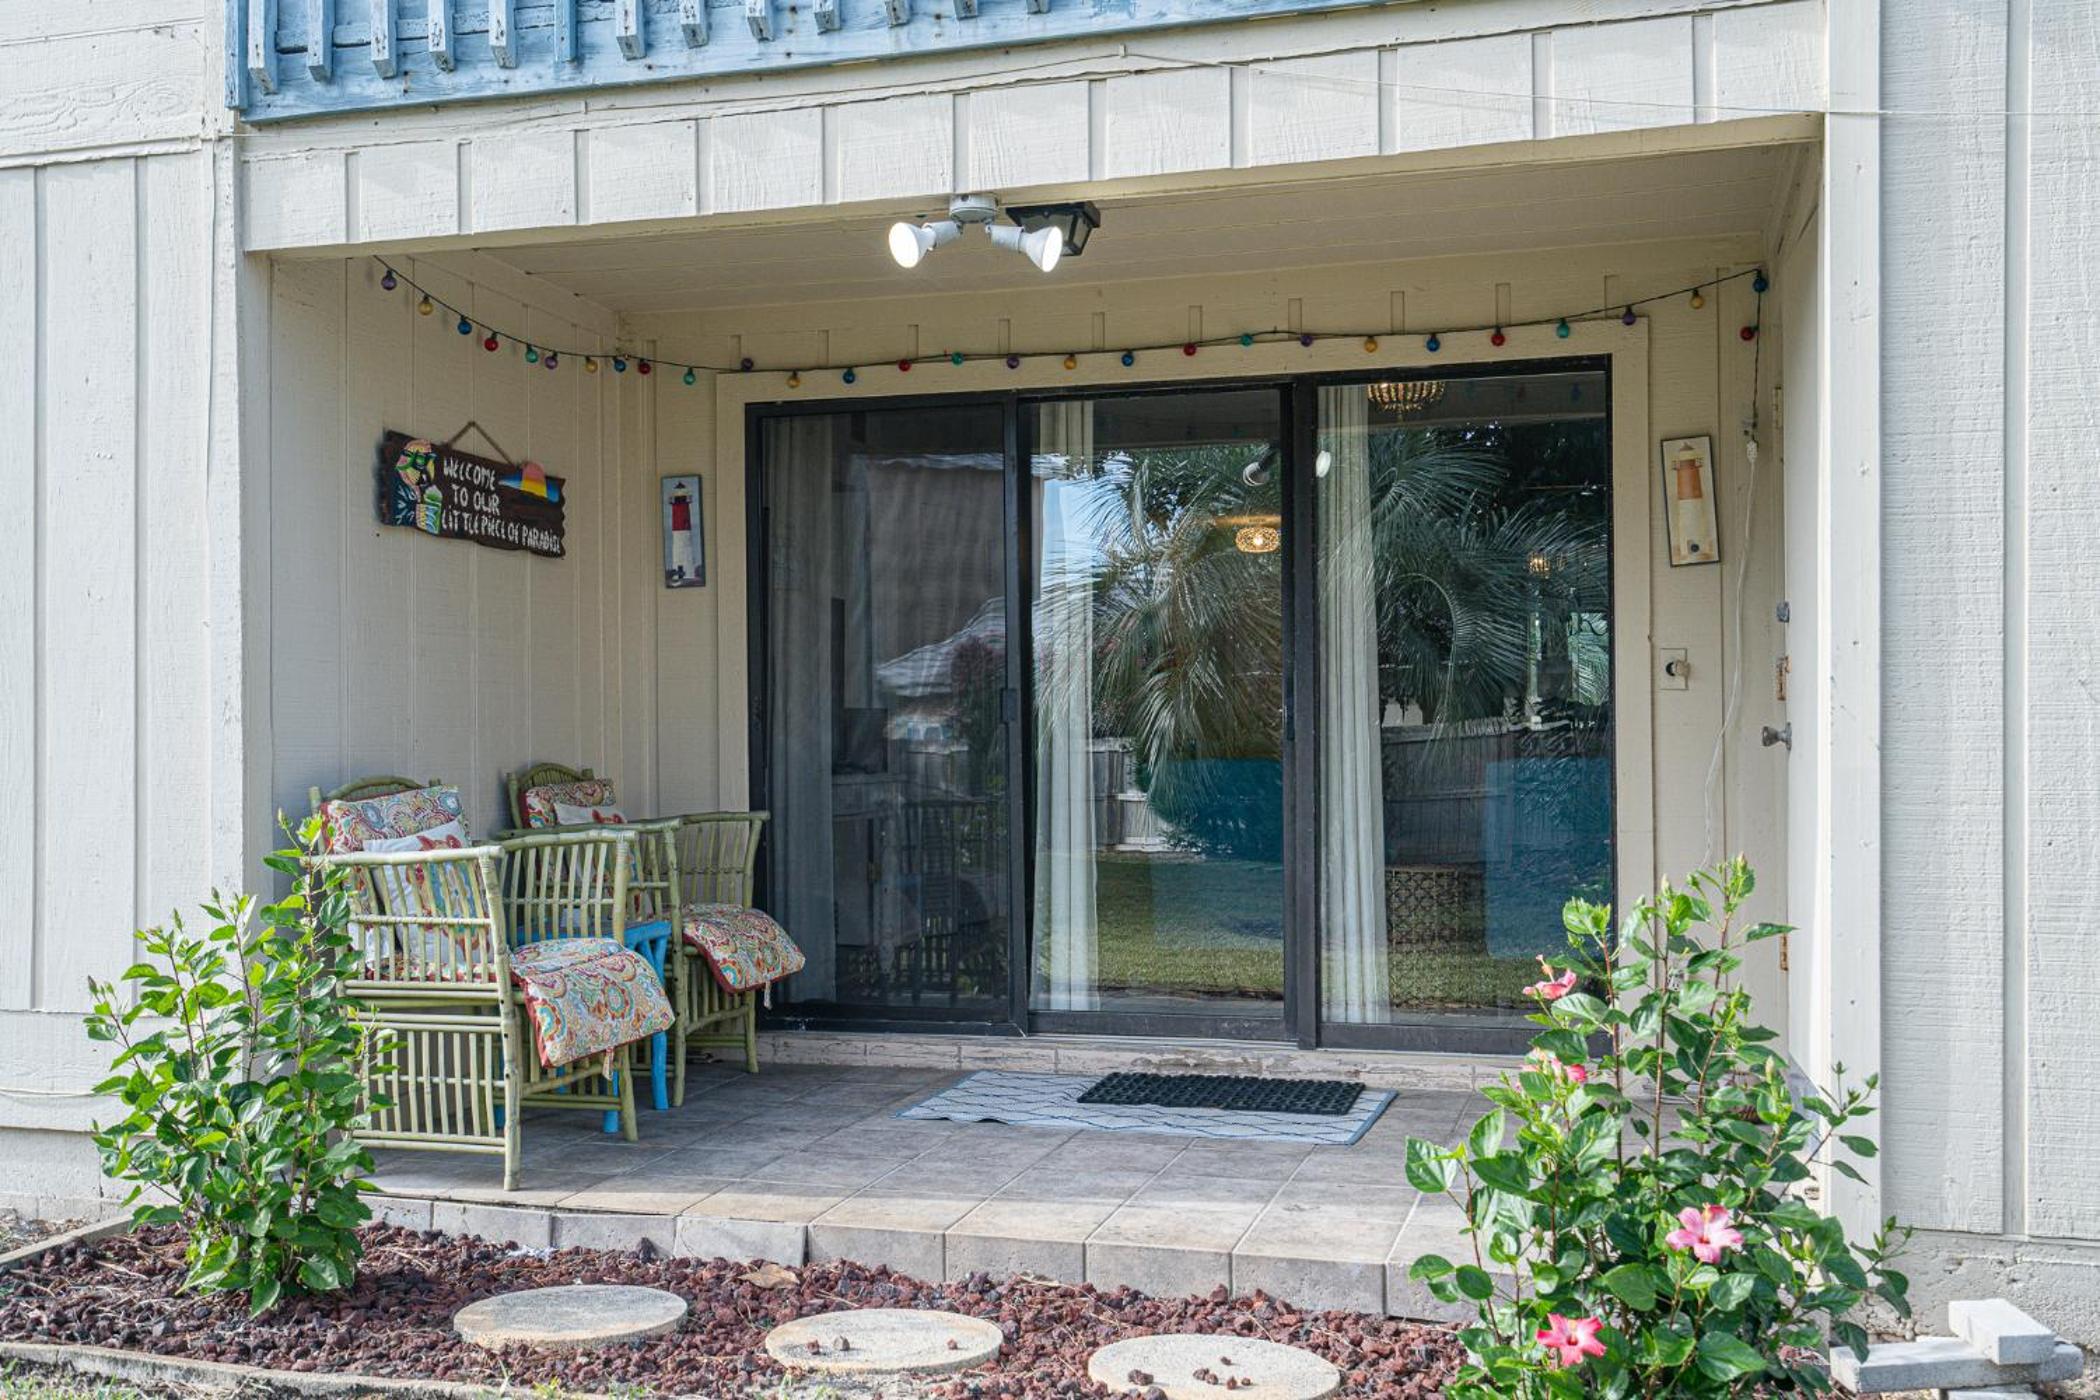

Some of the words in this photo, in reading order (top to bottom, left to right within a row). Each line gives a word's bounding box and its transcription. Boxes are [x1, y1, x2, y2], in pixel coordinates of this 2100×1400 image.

[443, 457, 496, 491] WELCOME
[451, 483, 469, 508] TO
[473, 491, 500, 516] OUR
[507, 522, 520, 544] OF
